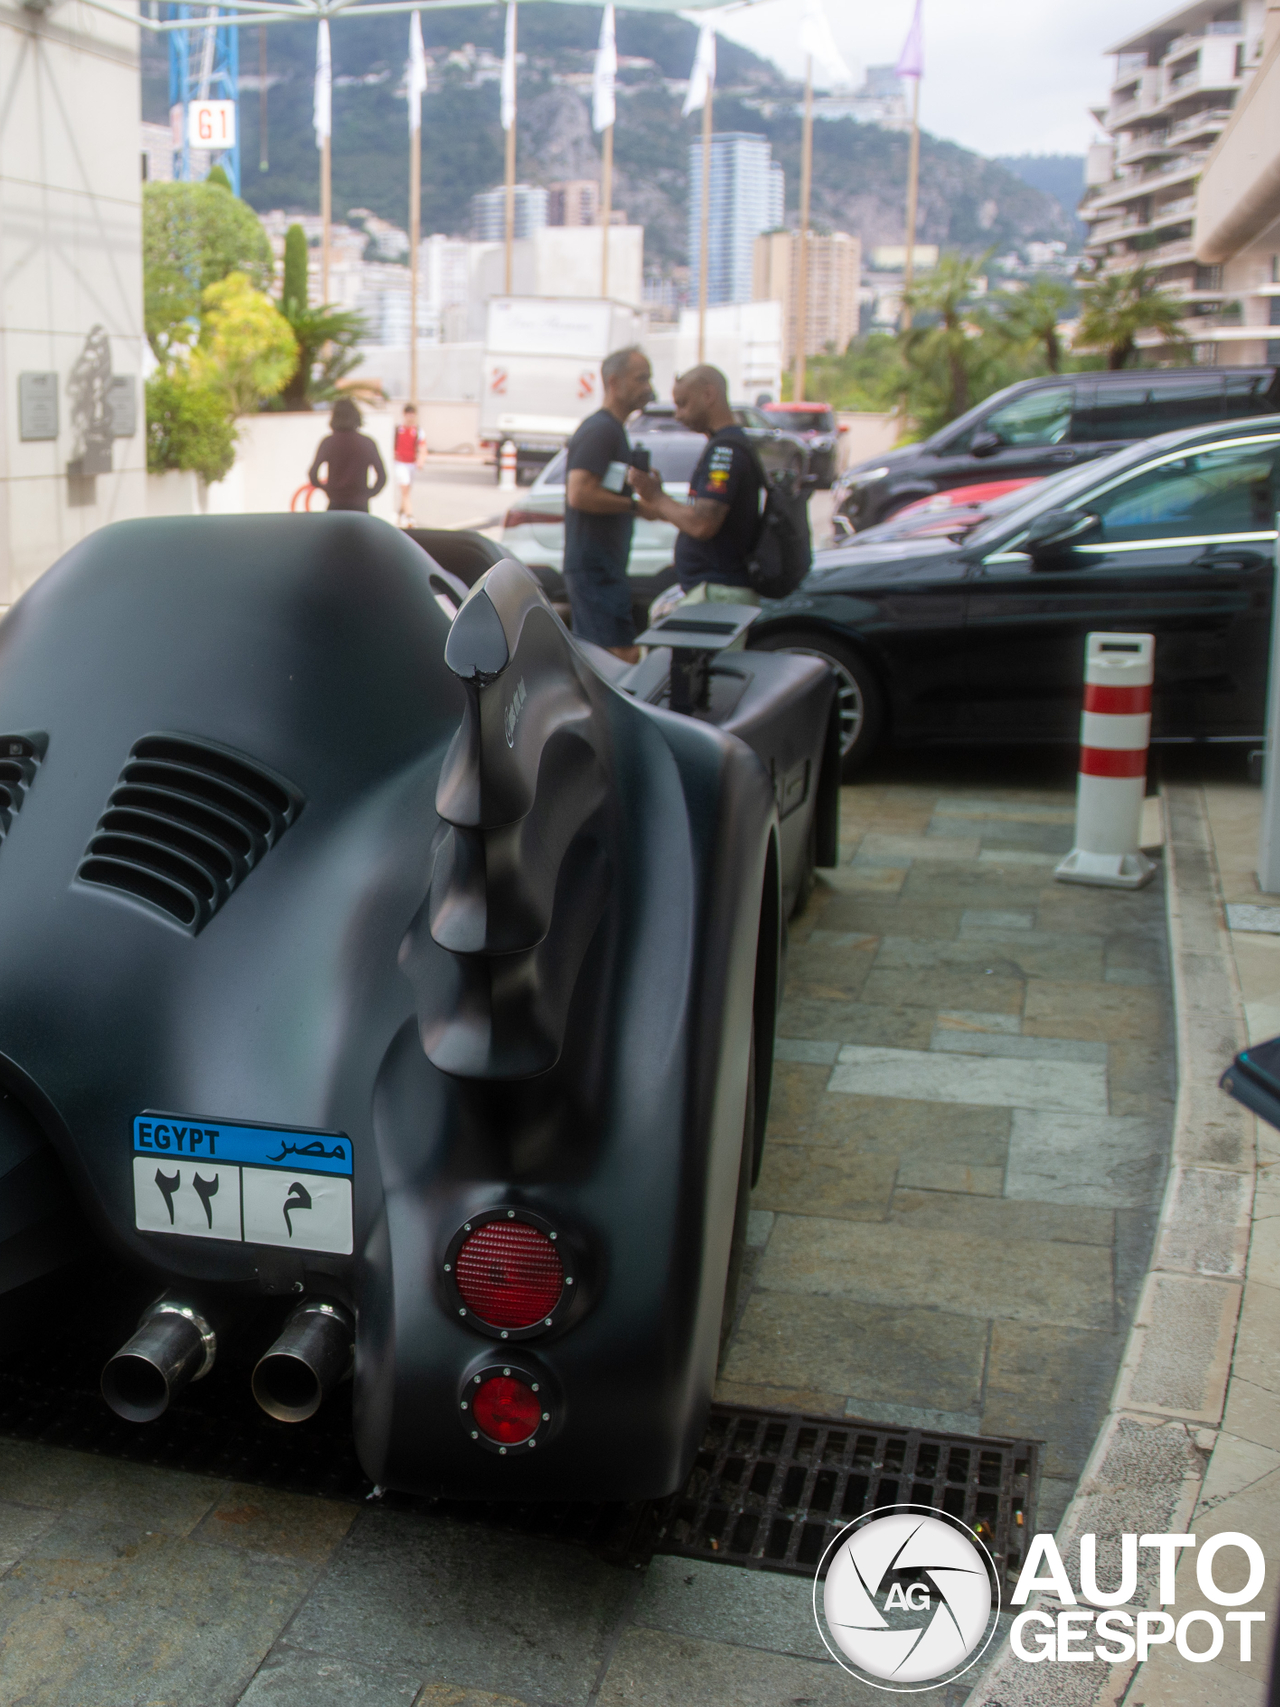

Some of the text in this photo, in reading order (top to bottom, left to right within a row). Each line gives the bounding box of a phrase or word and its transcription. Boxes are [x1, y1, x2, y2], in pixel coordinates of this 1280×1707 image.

[198, 108, 227, 140] G1
[138, 1122, 220, 1155] EGYPT
[265, 1139, 346, 1162] مصر
[154, 1167, 312, 1239] ٢٢ م
